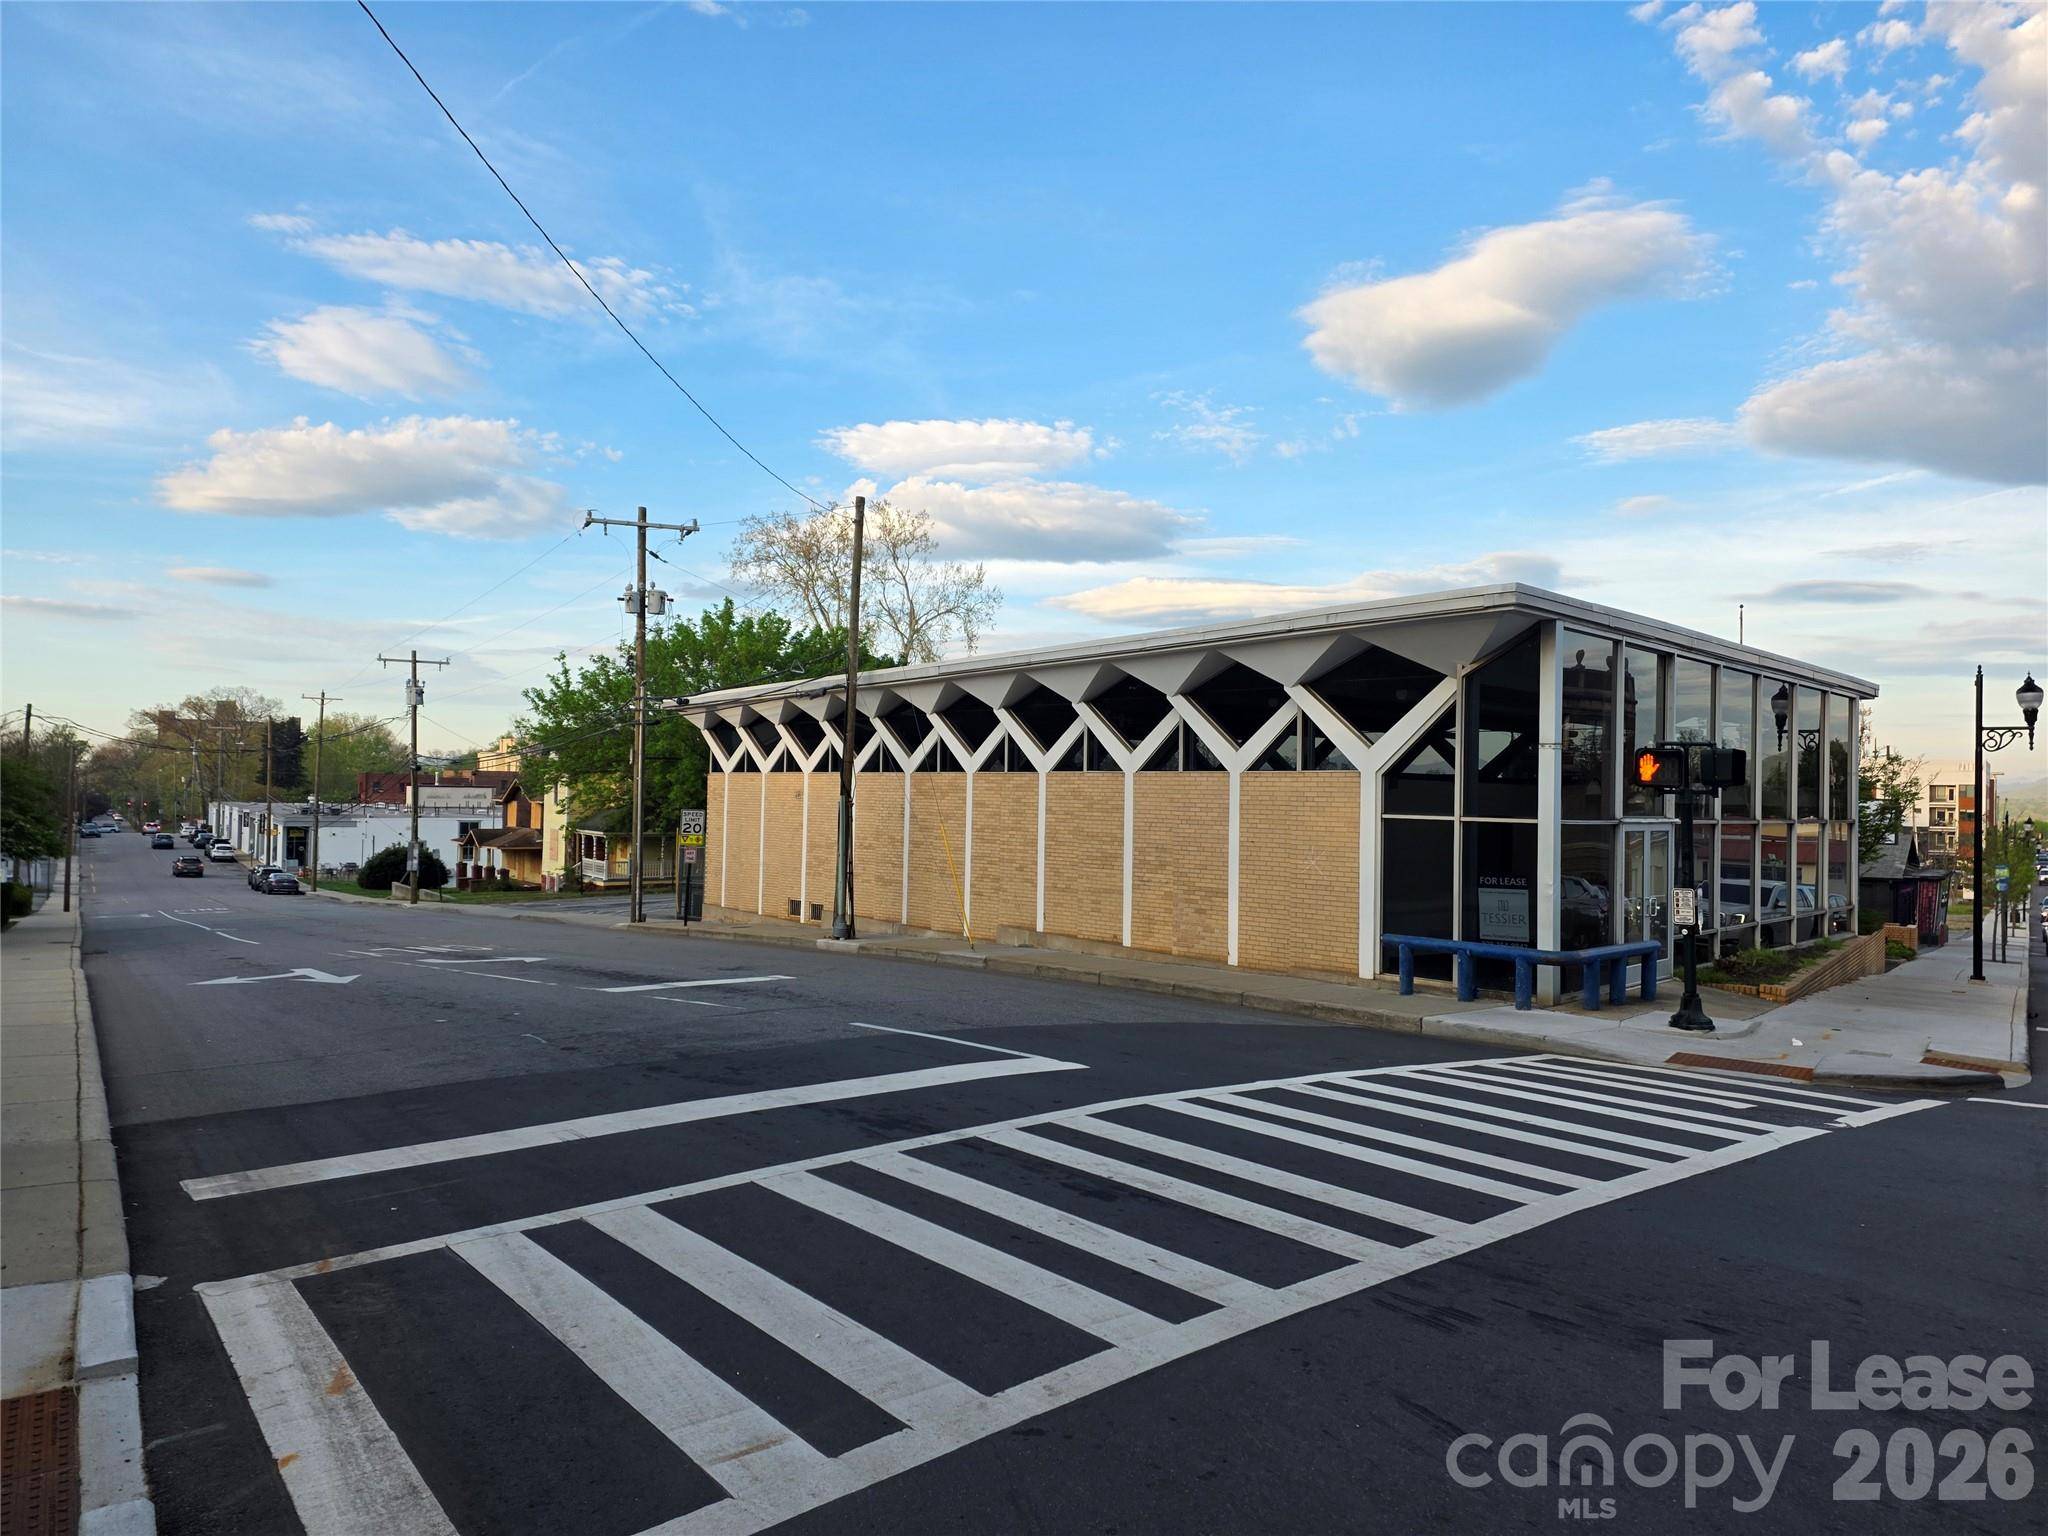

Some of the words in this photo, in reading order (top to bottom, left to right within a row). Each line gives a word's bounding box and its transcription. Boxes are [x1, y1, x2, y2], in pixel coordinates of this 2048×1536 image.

[682, 823, 702, 834] 20
[1479, 876, 1498, 885] FOR
[1499, 877, 1528, 886] LEASE
[1480, 912, 1527, 925] TESSIER
